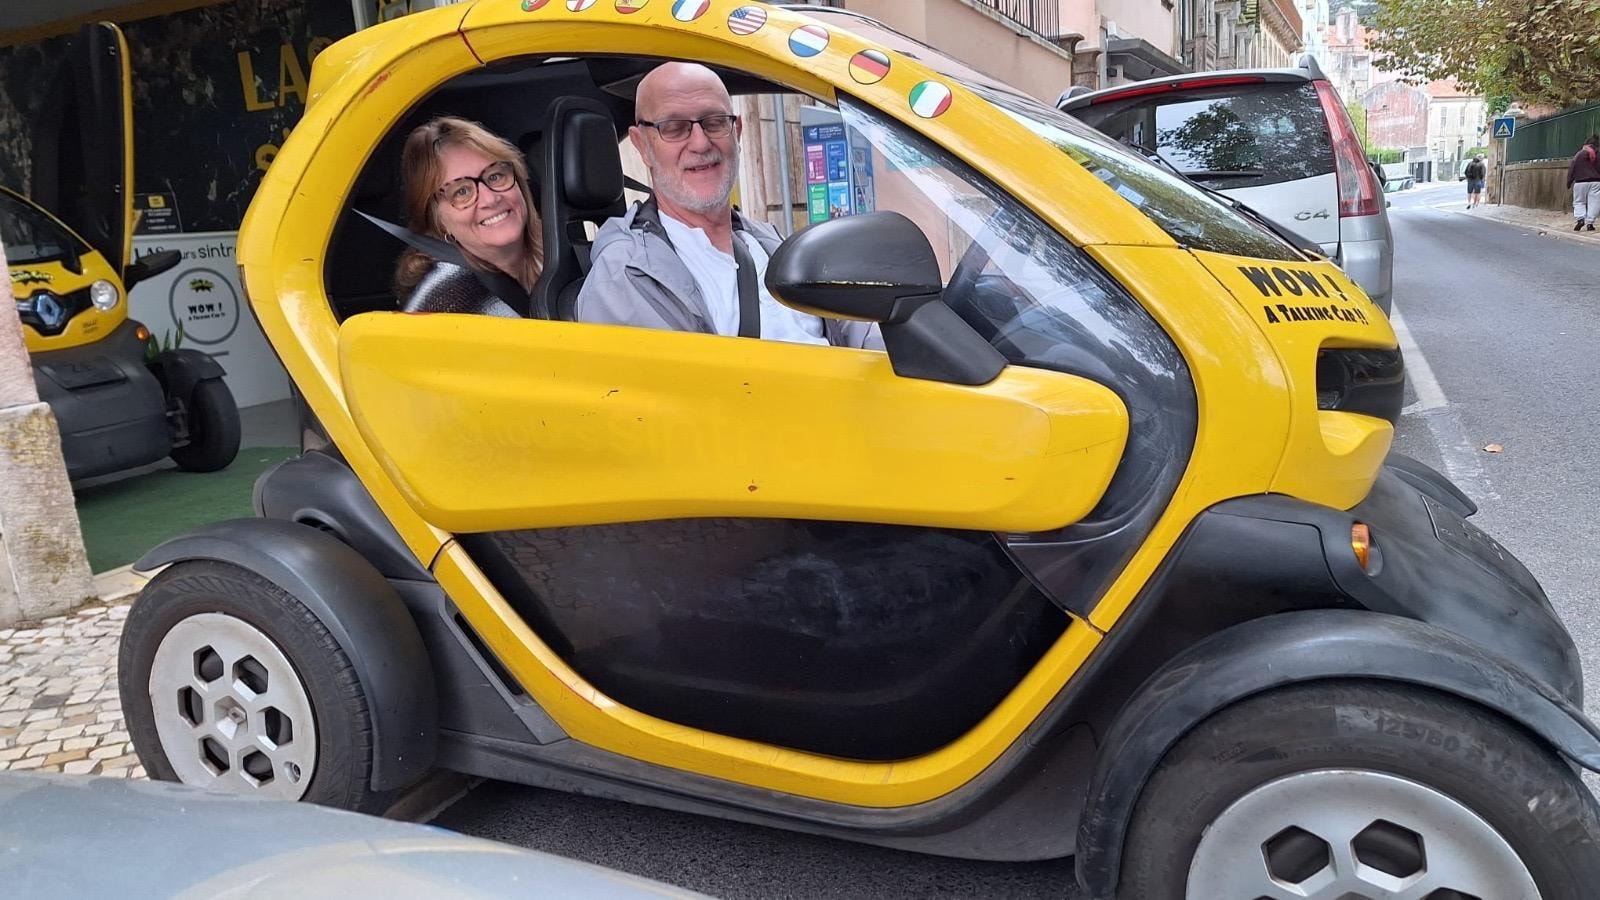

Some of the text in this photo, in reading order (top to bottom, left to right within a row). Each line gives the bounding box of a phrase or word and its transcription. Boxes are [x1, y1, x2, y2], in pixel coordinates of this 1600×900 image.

[1294, 209, 1330, 221] C4
[198, 242, 236, 259] sintr
[1237, 266, 1330, 298] WOW
[187, 303, 214, 315] WOW
[1263, 305, 1280, 323] A
